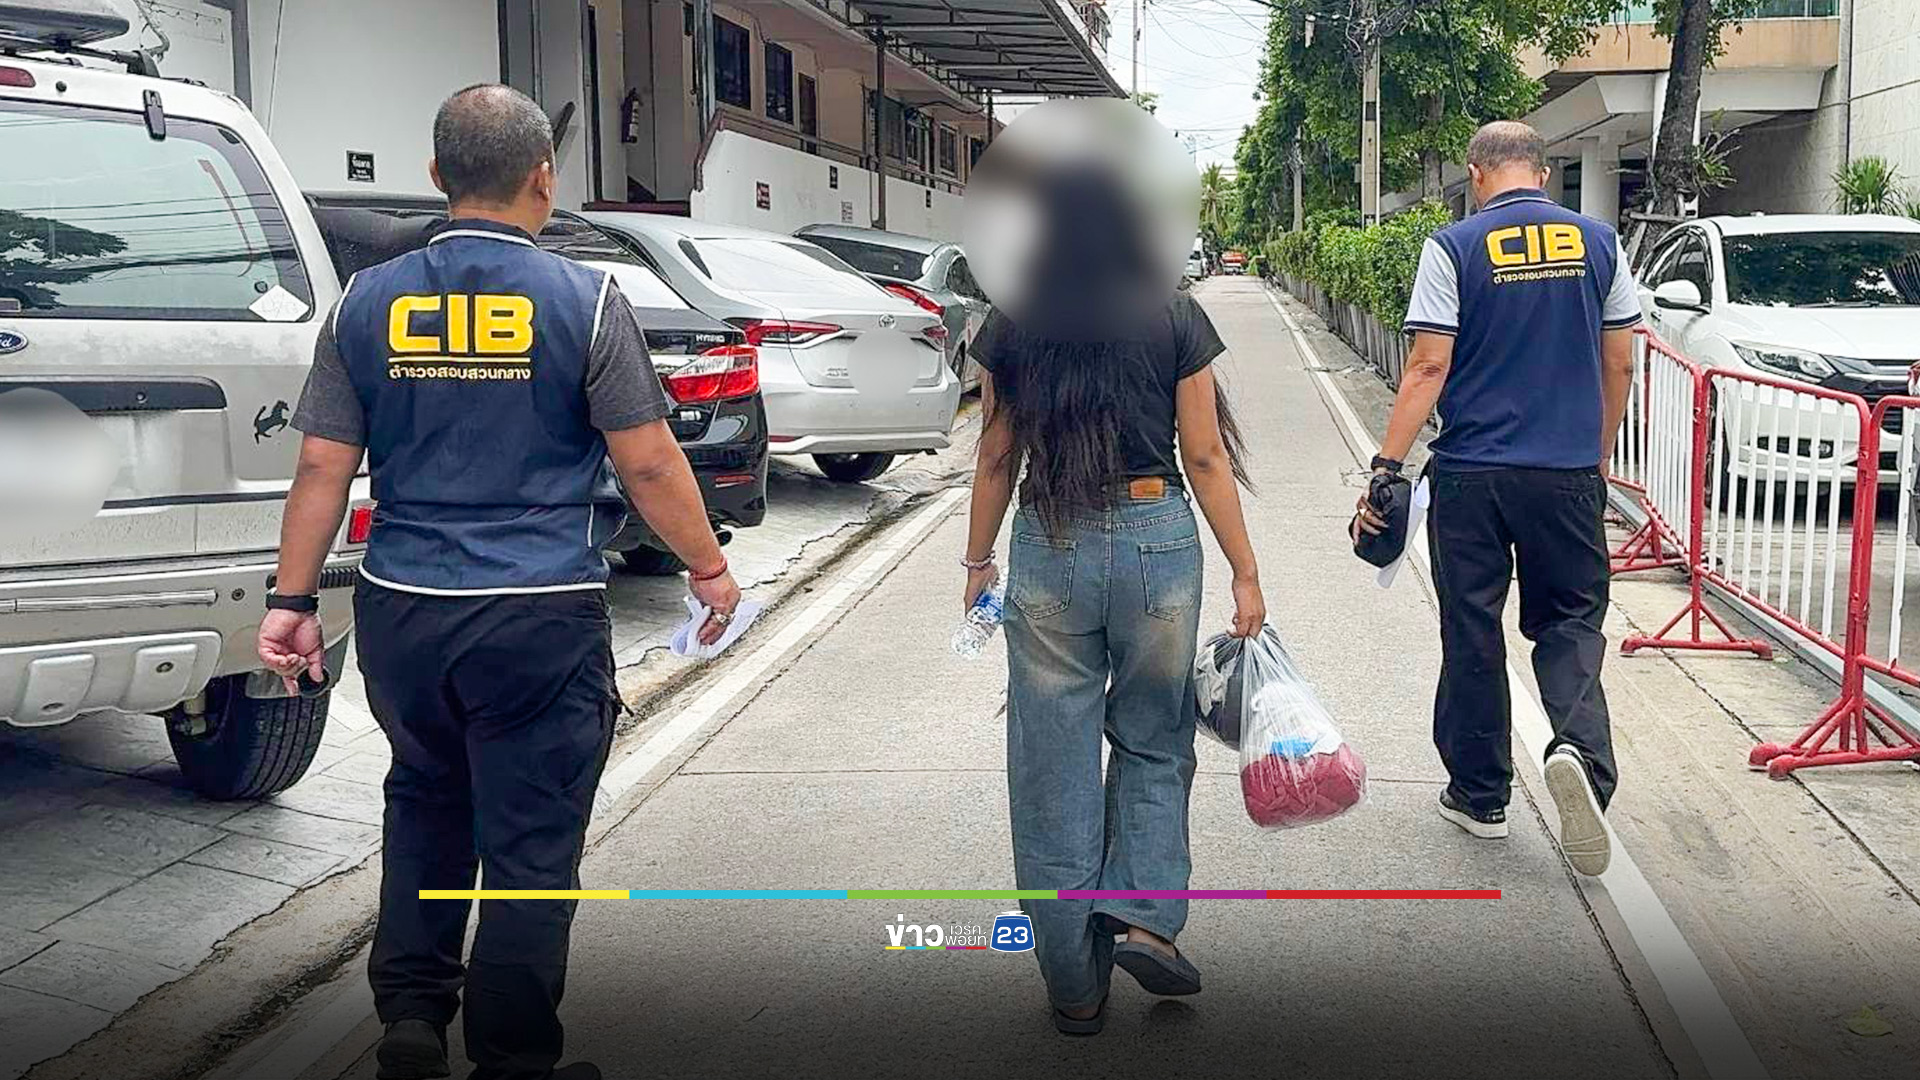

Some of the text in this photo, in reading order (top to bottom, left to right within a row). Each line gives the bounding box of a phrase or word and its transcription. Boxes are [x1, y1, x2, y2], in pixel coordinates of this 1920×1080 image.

[1486, 223, 1585, 266] CIB
[388, 293, 534, 353] CIB
[388, 364, 532, 380] ตำรวจสอบสวนกลาง
